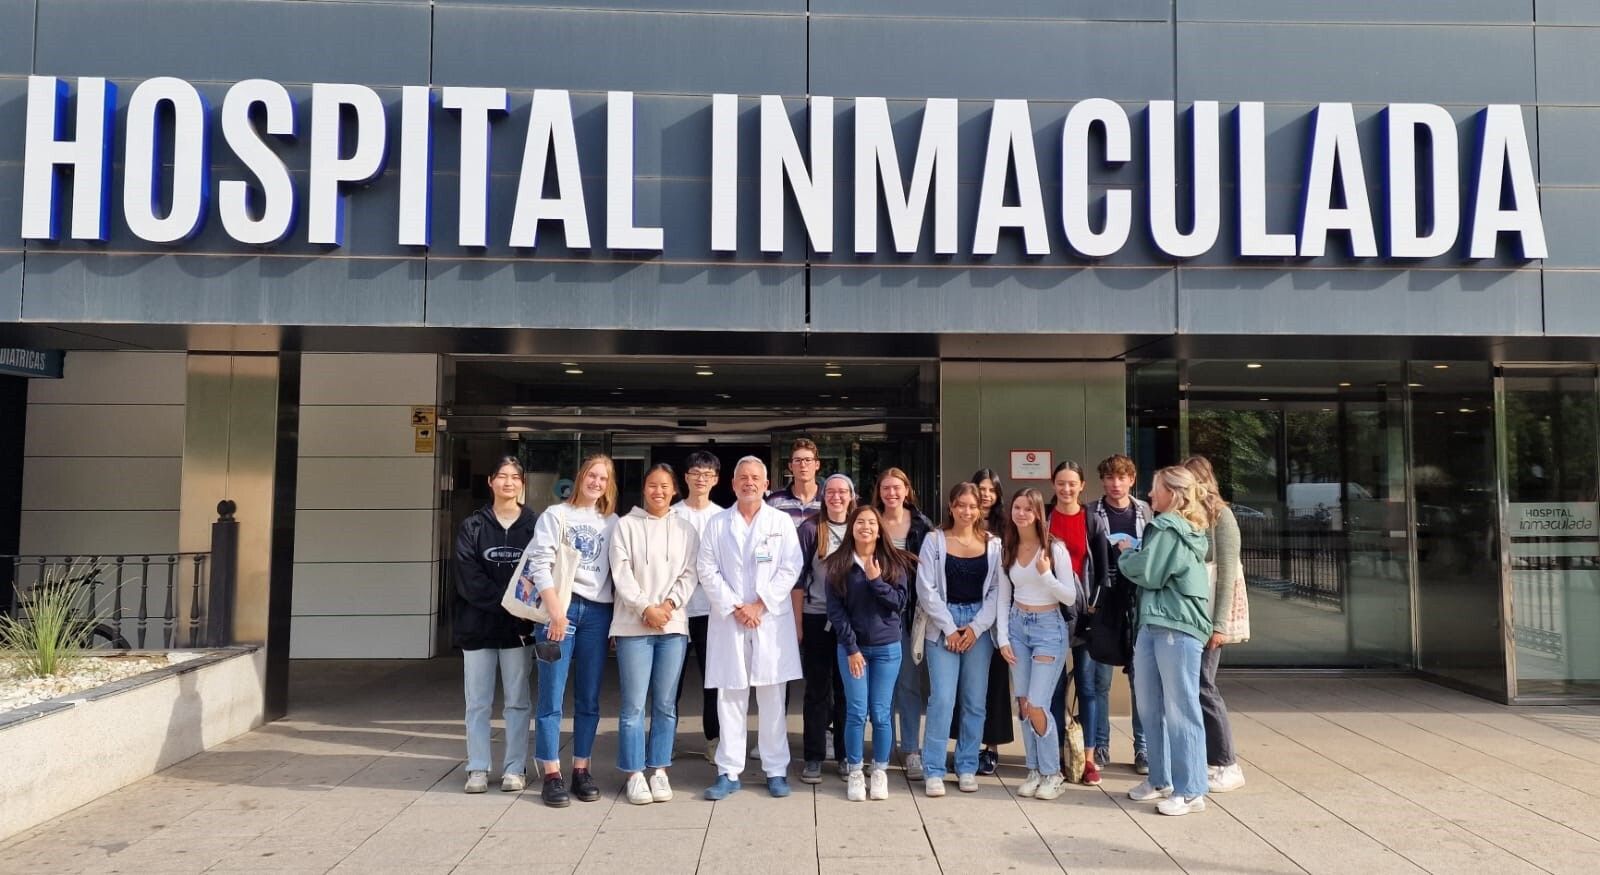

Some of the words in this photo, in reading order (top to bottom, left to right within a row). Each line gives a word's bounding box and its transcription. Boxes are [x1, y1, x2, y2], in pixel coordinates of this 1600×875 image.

[22, 76, 664, 250] HOSPITAL
[711, 94, 1549, 261] INMACULADA
[1526, 508, 1574, 517] HOSPITAL
[1520, 517, 1592, 530] inmaculada
